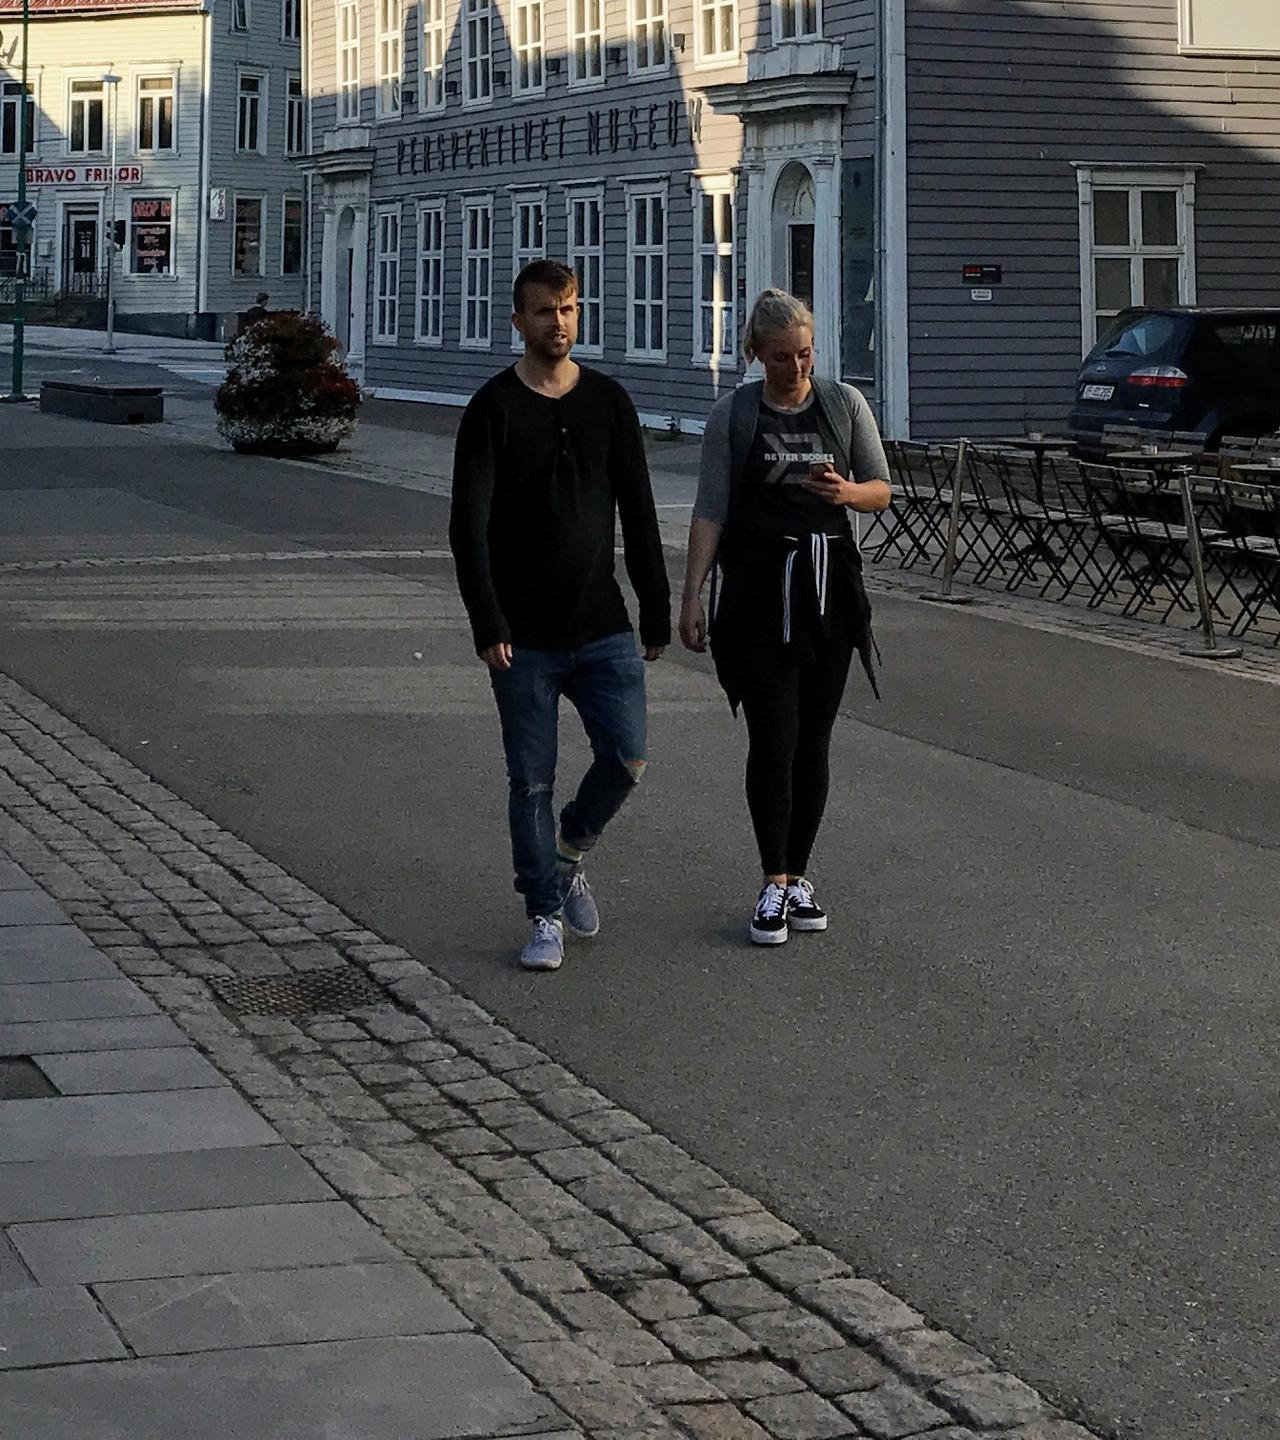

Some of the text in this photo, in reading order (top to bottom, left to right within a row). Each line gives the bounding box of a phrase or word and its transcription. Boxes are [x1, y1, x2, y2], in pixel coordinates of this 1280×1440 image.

[397, 98, 702, 176] PERSPEKTIVET MUSEUM
[25, 167, 140, 183] BRAVO FRISØR
